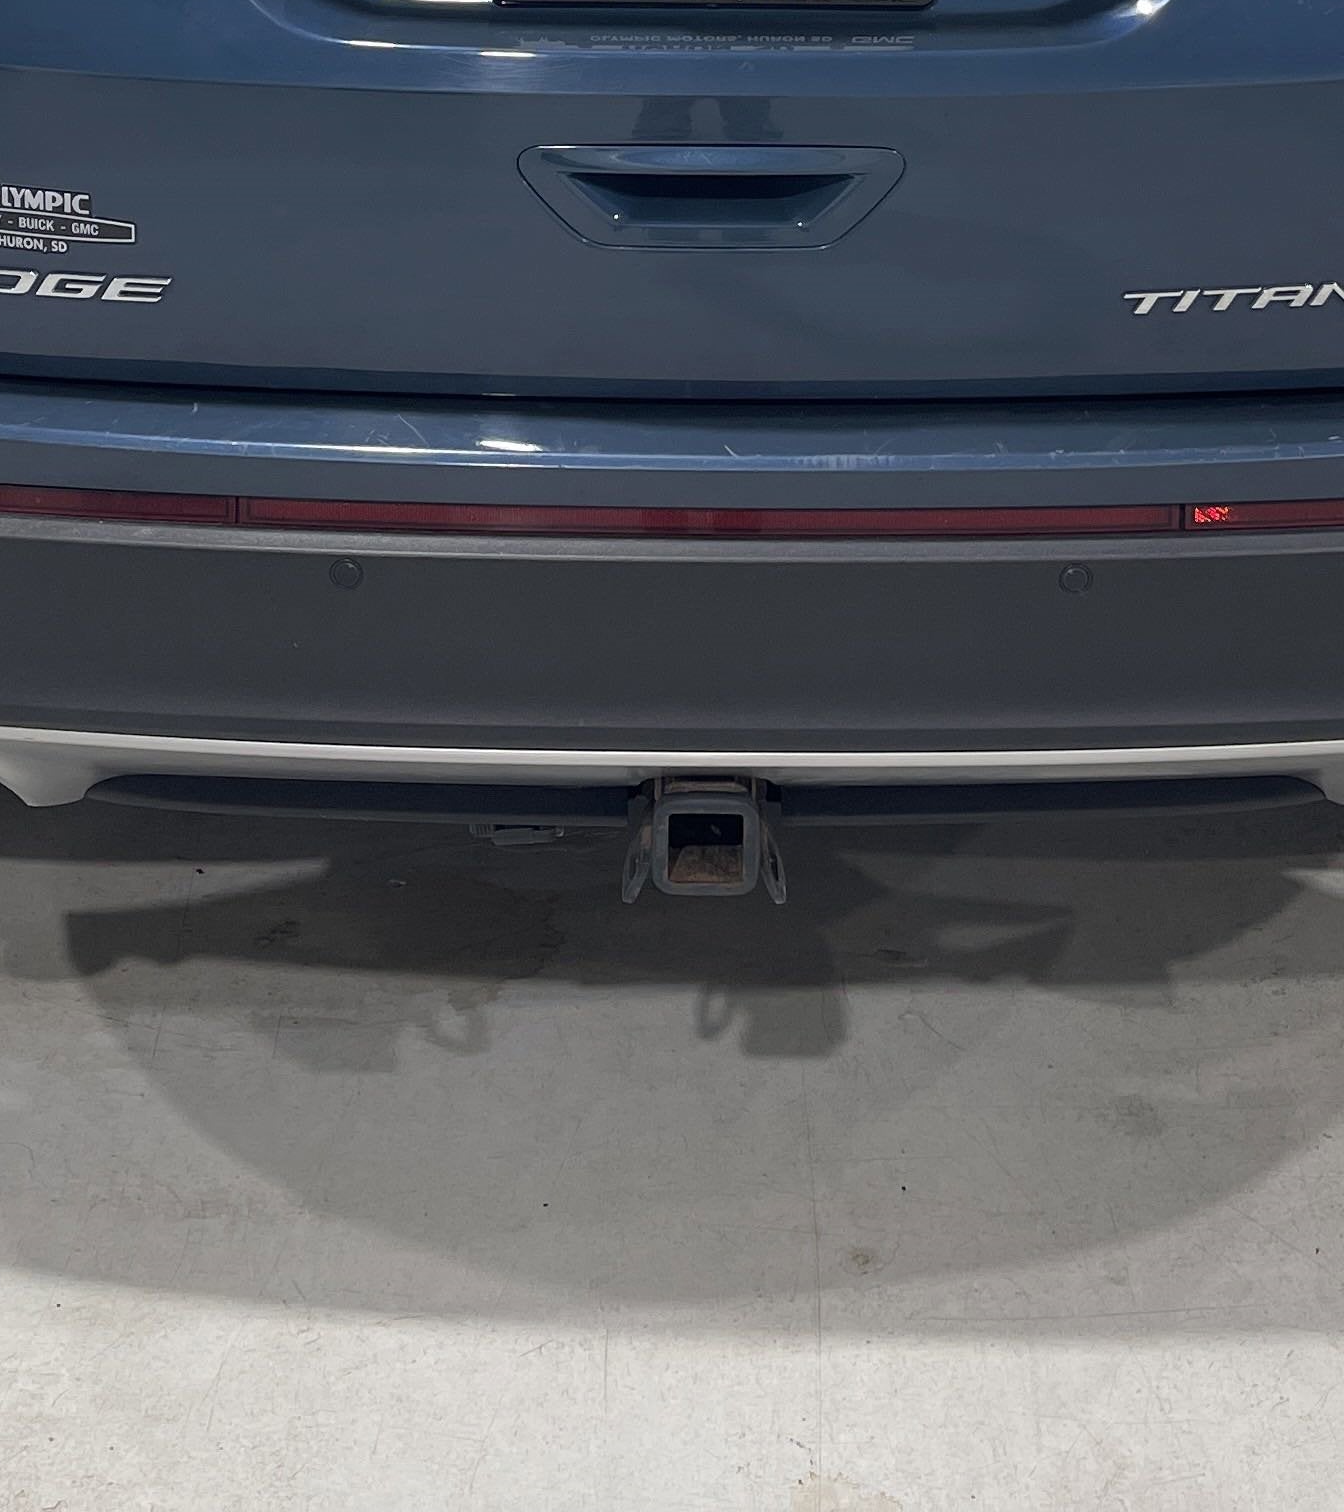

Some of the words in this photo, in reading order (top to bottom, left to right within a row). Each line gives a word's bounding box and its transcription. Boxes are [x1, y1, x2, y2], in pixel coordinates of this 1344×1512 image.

[18, 218, 54, 232] BUICK
[71, 223, 99, 235] GMC
[51, 240, 67, 253] SD
